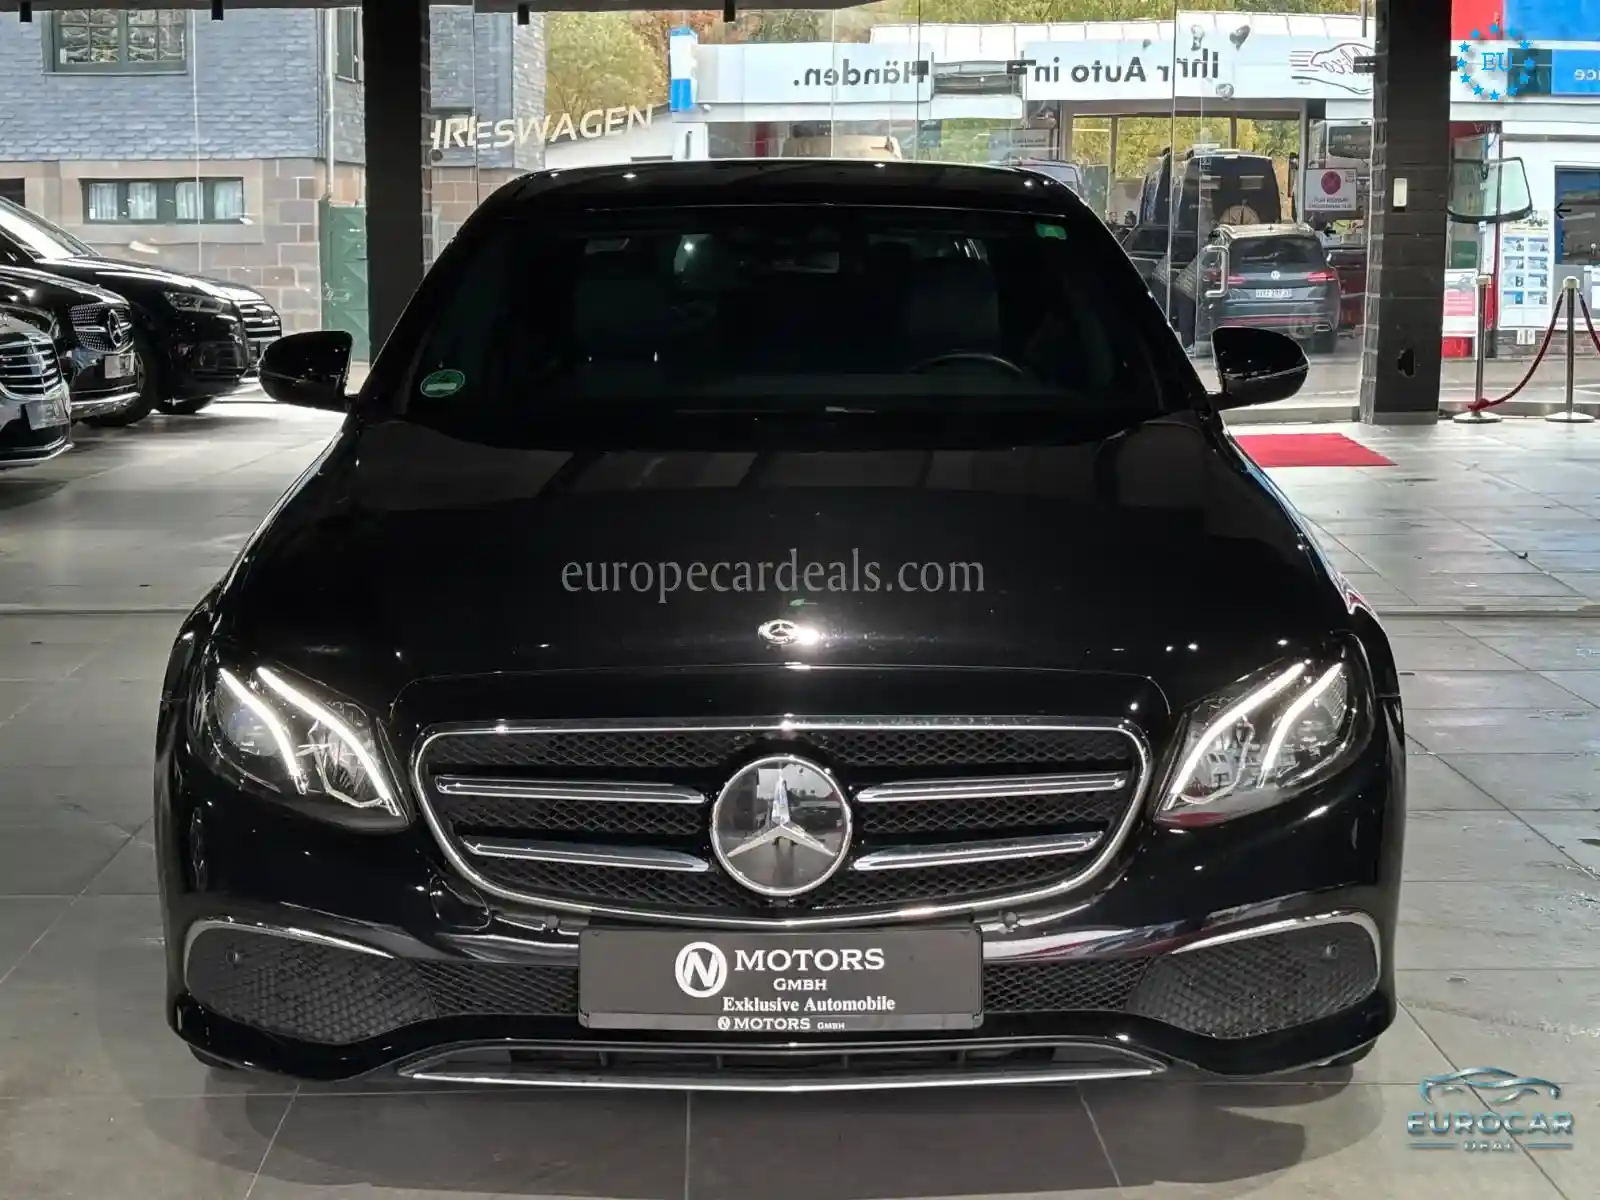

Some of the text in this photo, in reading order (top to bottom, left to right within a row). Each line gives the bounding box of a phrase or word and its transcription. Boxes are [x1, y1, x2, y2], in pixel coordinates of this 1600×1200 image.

[733, 948, 885, 972] MOTORS
[773, 977, 828, 992] GMBH
[722, 996, 896, 1013] Exklusive Automobile
[734, 1017, 811, 1031] MOTORS
